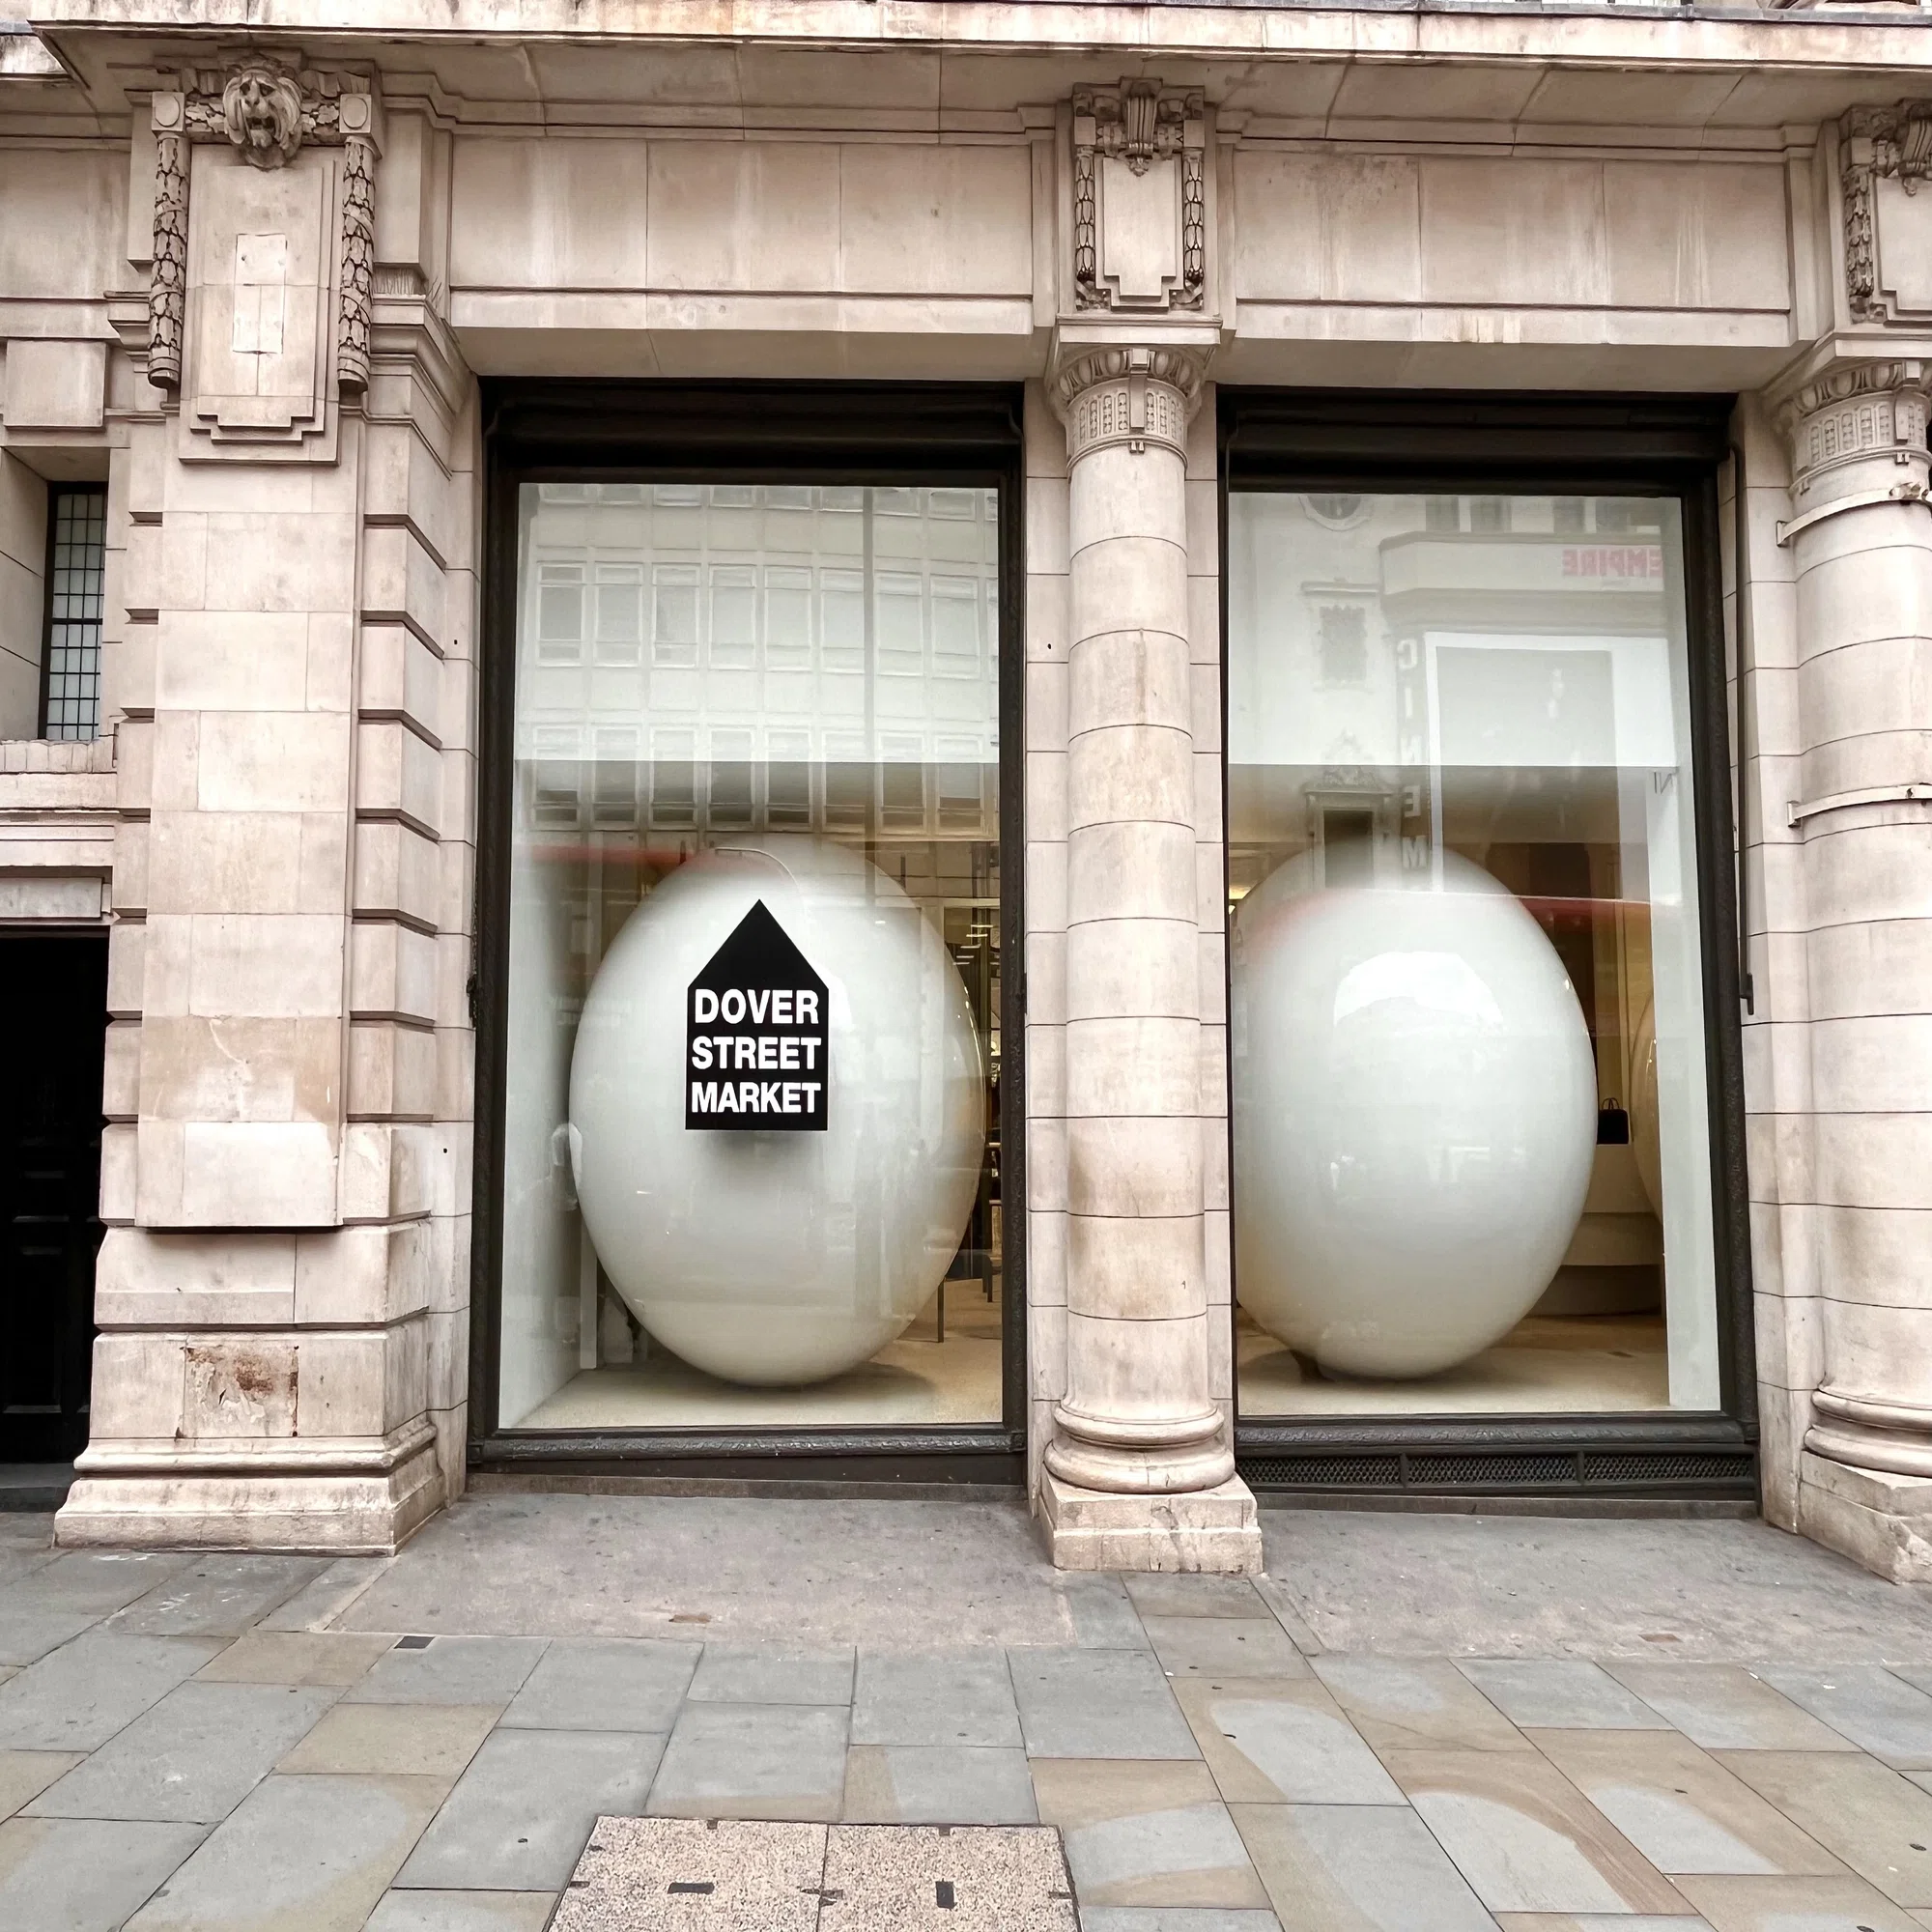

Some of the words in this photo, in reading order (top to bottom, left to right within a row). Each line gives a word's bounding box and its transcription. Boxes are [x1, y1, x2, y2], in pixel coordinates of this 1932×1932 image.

[695, 988, 819, 1024] DOVER
[692, 1036, 822, 1069] STREET
[691, 1081, 821, 1113] MARKET
